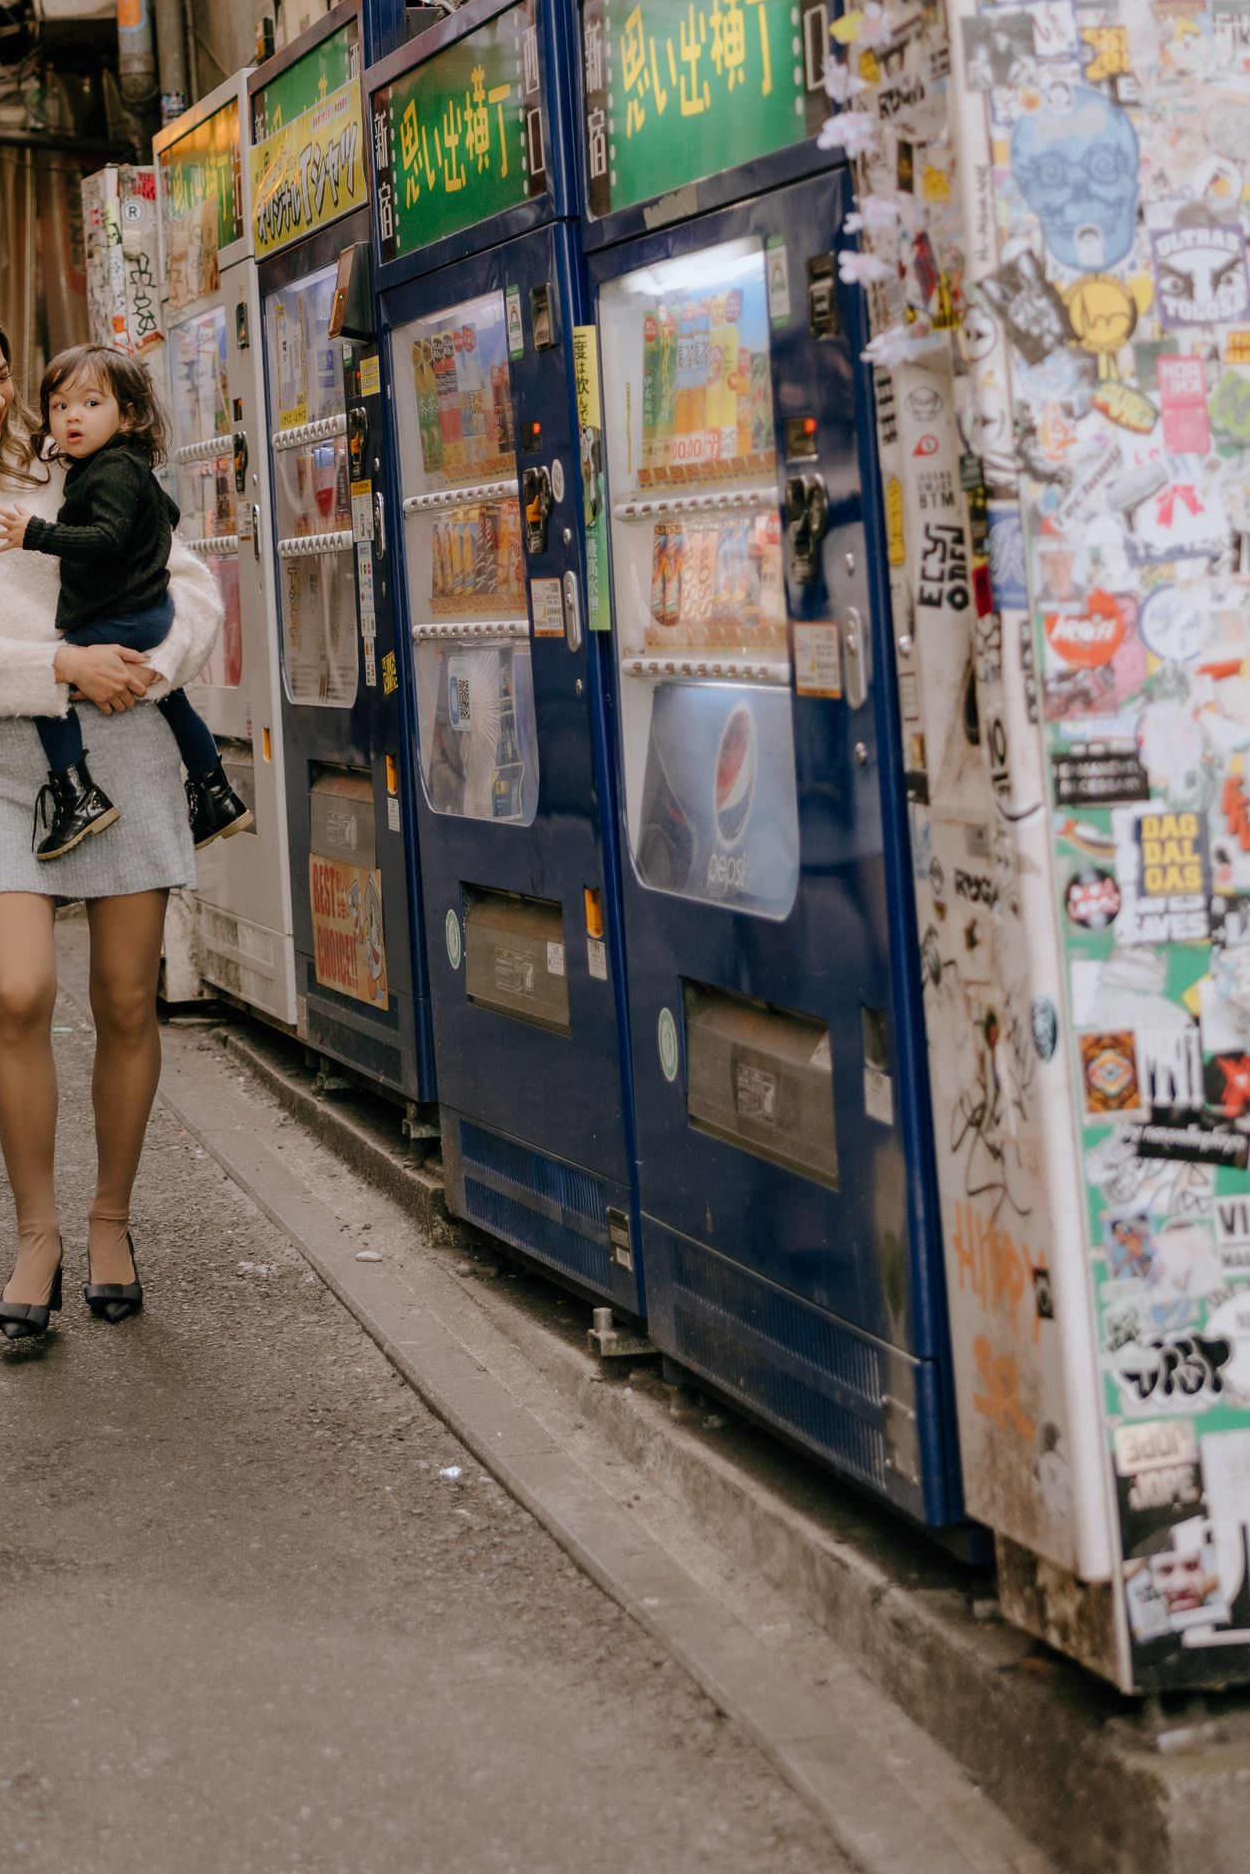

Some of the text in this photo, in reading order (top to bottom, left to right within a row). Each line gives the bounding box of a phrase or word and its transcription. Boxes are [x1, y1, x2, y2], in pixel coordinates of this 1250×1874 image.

[399, 64, 511, 210] 思い出横丁
[522, 25, 546, 176] 西口
[583, 21, 607, 179] 新宿
[373, 109, 394, 242] 新宿
[1155, 227, 1241, 259] ULTRAS
[312, 862, 335, 919] BEST
[707, 851, 748, 890] pepsi
[1143, 840, 1202, 865] DAL
